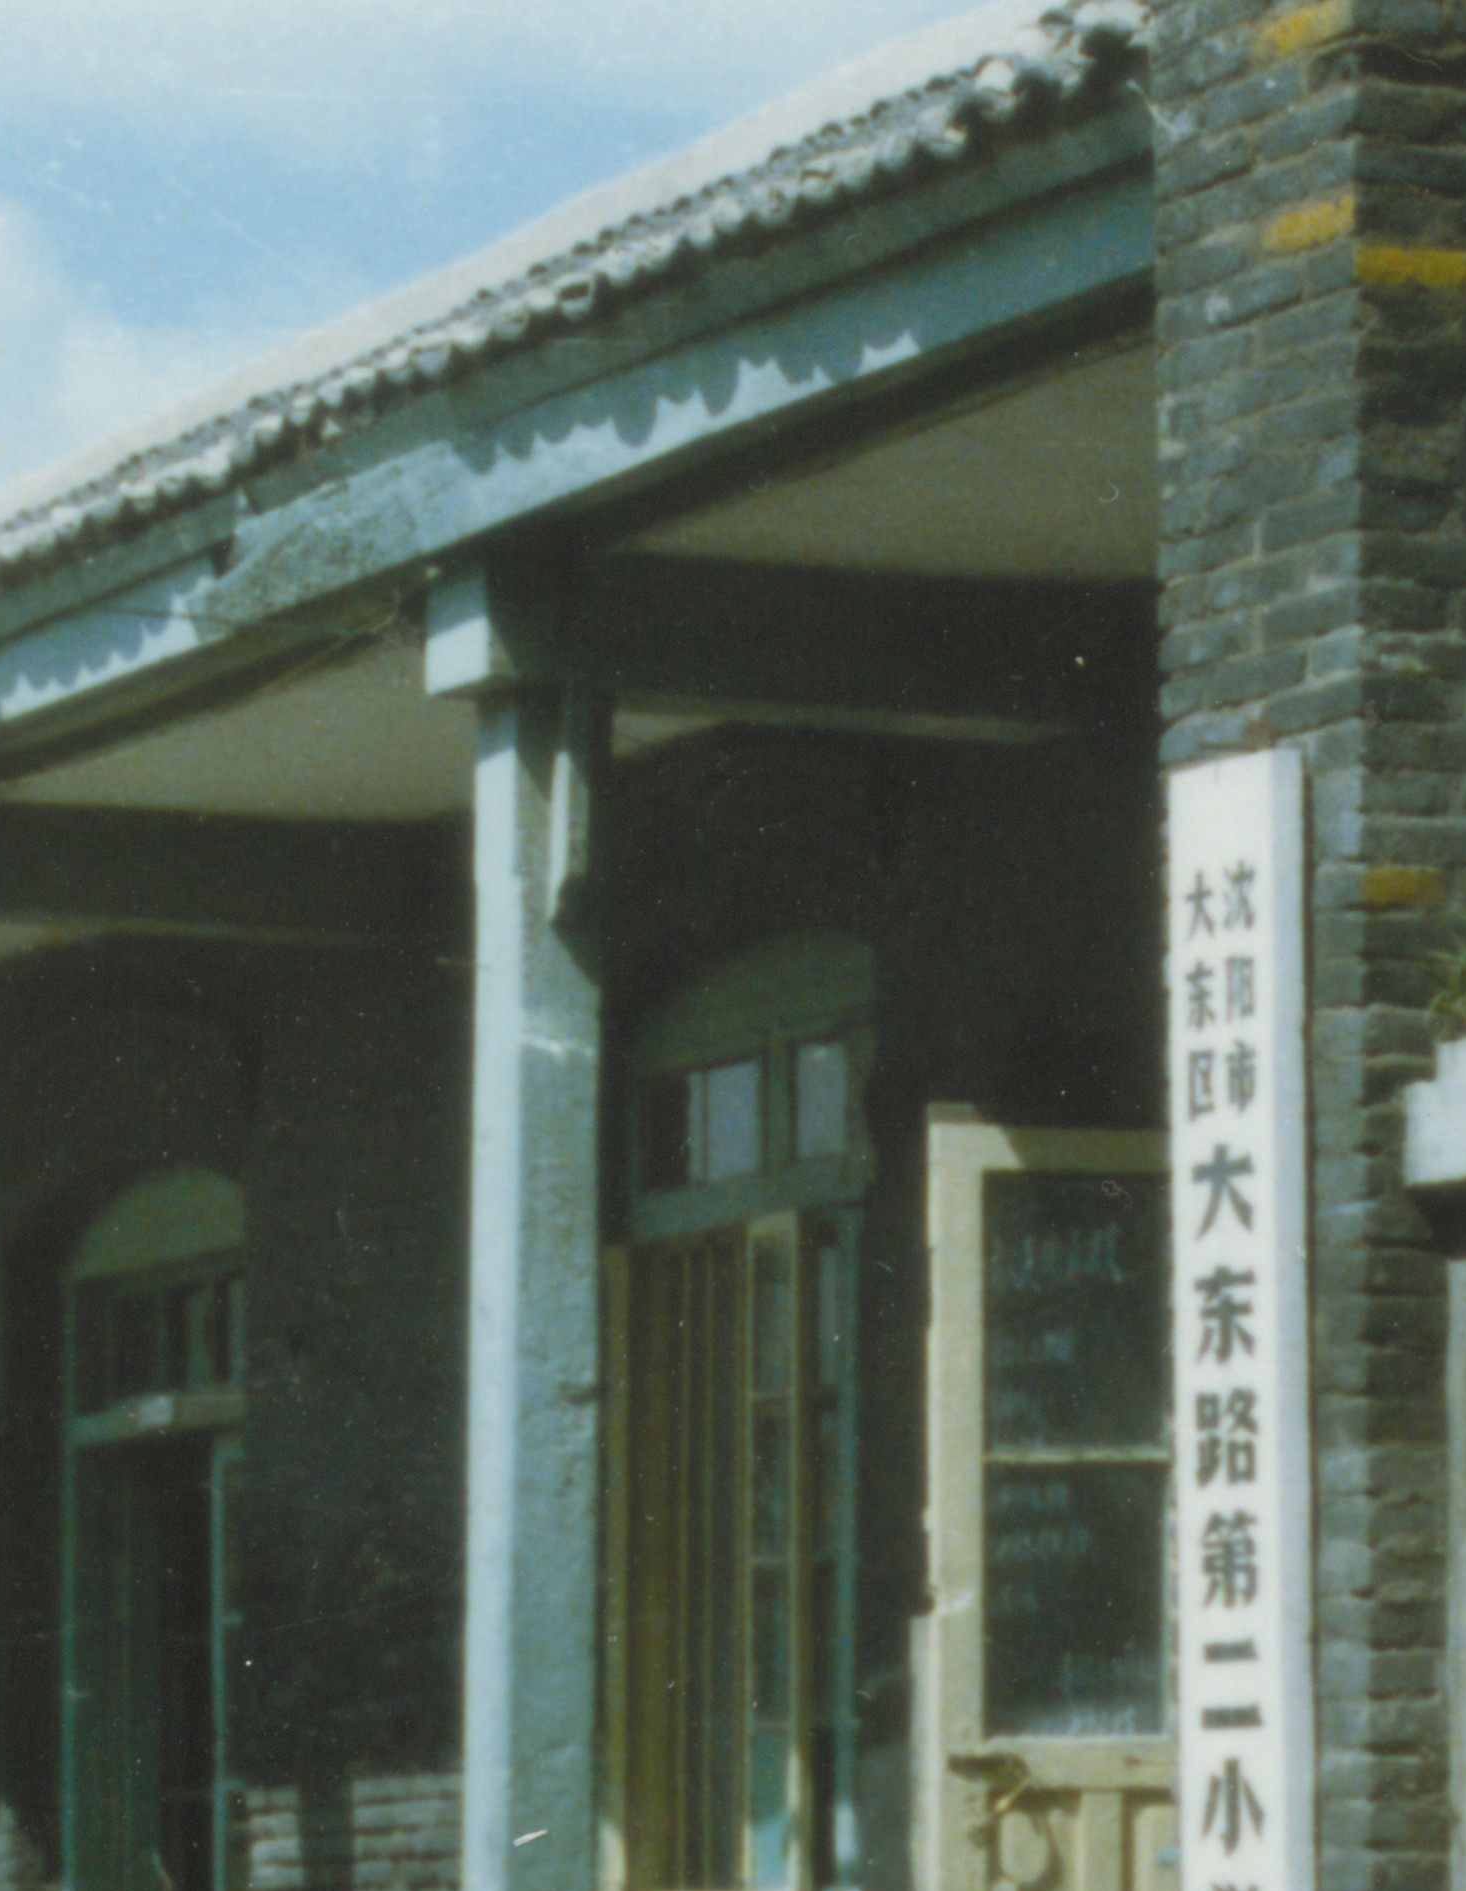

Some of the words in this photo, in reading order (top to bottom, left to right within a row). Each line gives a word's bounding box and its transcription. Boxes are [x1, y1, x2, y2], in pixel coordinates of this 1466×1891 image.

[1185, 870, 1215, 1122] 大东区
[1223, 861, 1257, 1112] 沈阳市
